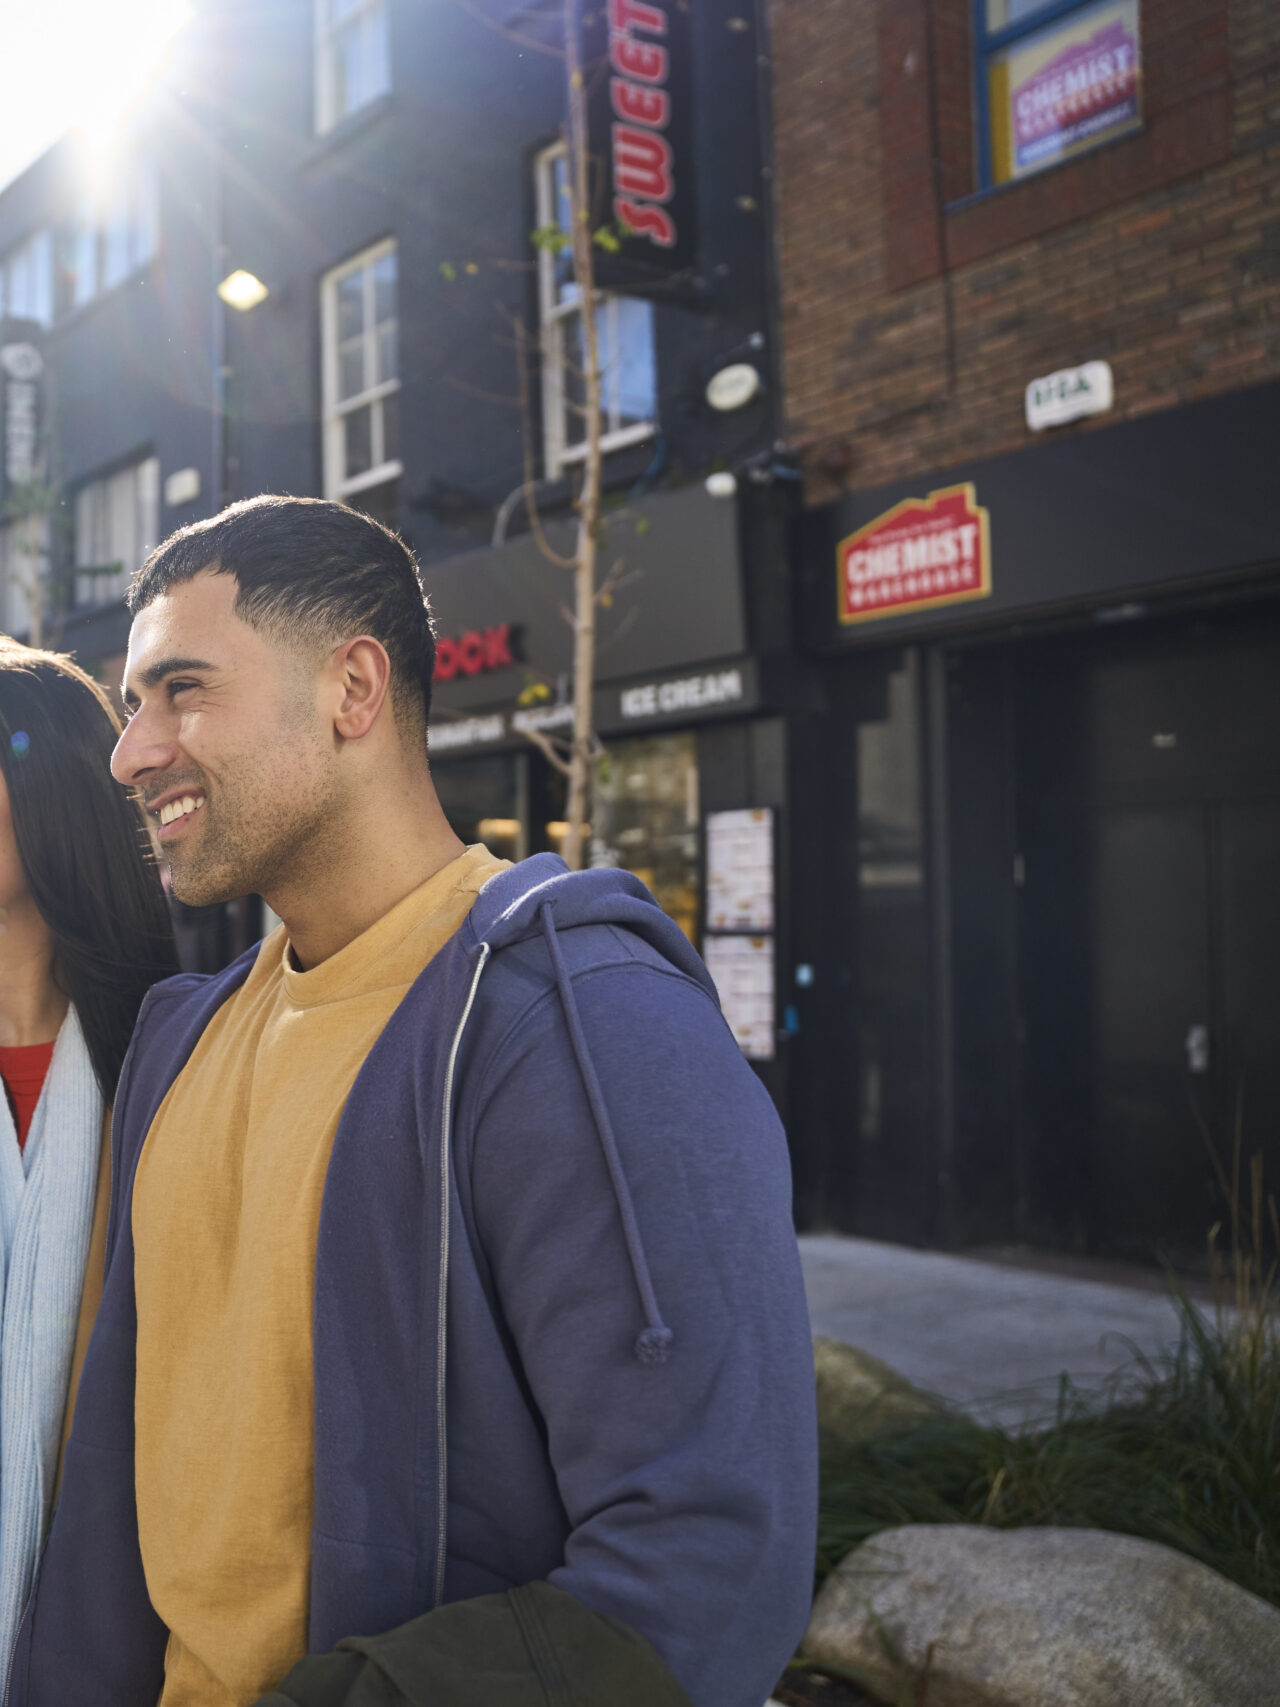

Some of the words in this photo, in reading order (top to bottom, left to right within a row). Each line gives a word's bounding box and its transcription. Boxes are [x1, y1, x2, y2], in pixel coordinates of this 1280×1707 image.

[1016, 44, 1129, 118] CHEMIST
[610, 0, 674, 245] SWEET
[848, 523, 977, 585] CHEMIST
[433, 623, 512, 681] OCK
[621, 685, 656, 718] ICE
[659, 669, 741, 712] CREAM
